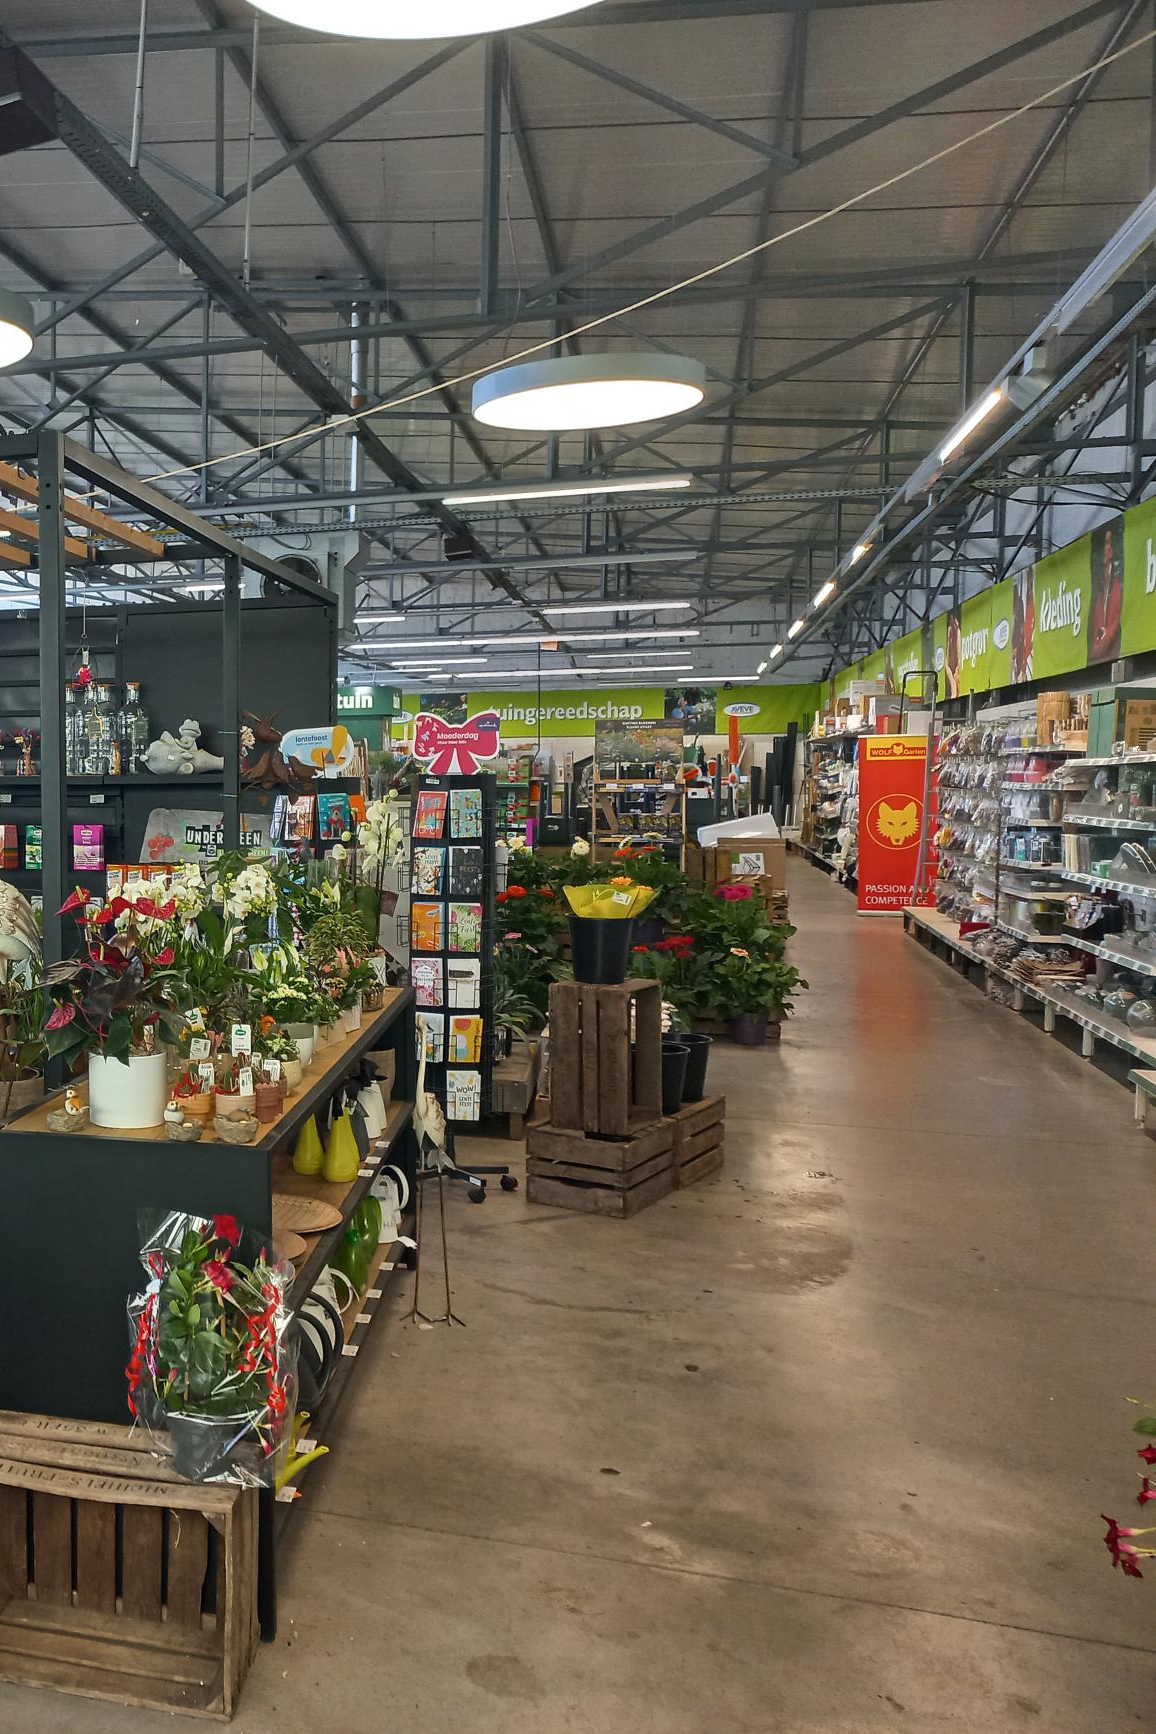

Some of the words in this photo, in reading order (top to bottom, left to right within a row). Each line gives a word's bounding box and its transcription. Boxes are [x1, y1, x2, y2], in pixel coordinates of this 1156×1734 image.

[1040, 579, 1082, 637] kleding
[731, 705, 754, 713] AVEVE
[437, 732, 479, 741] Moederdag
[865, 884, 907, 893] PASSION
